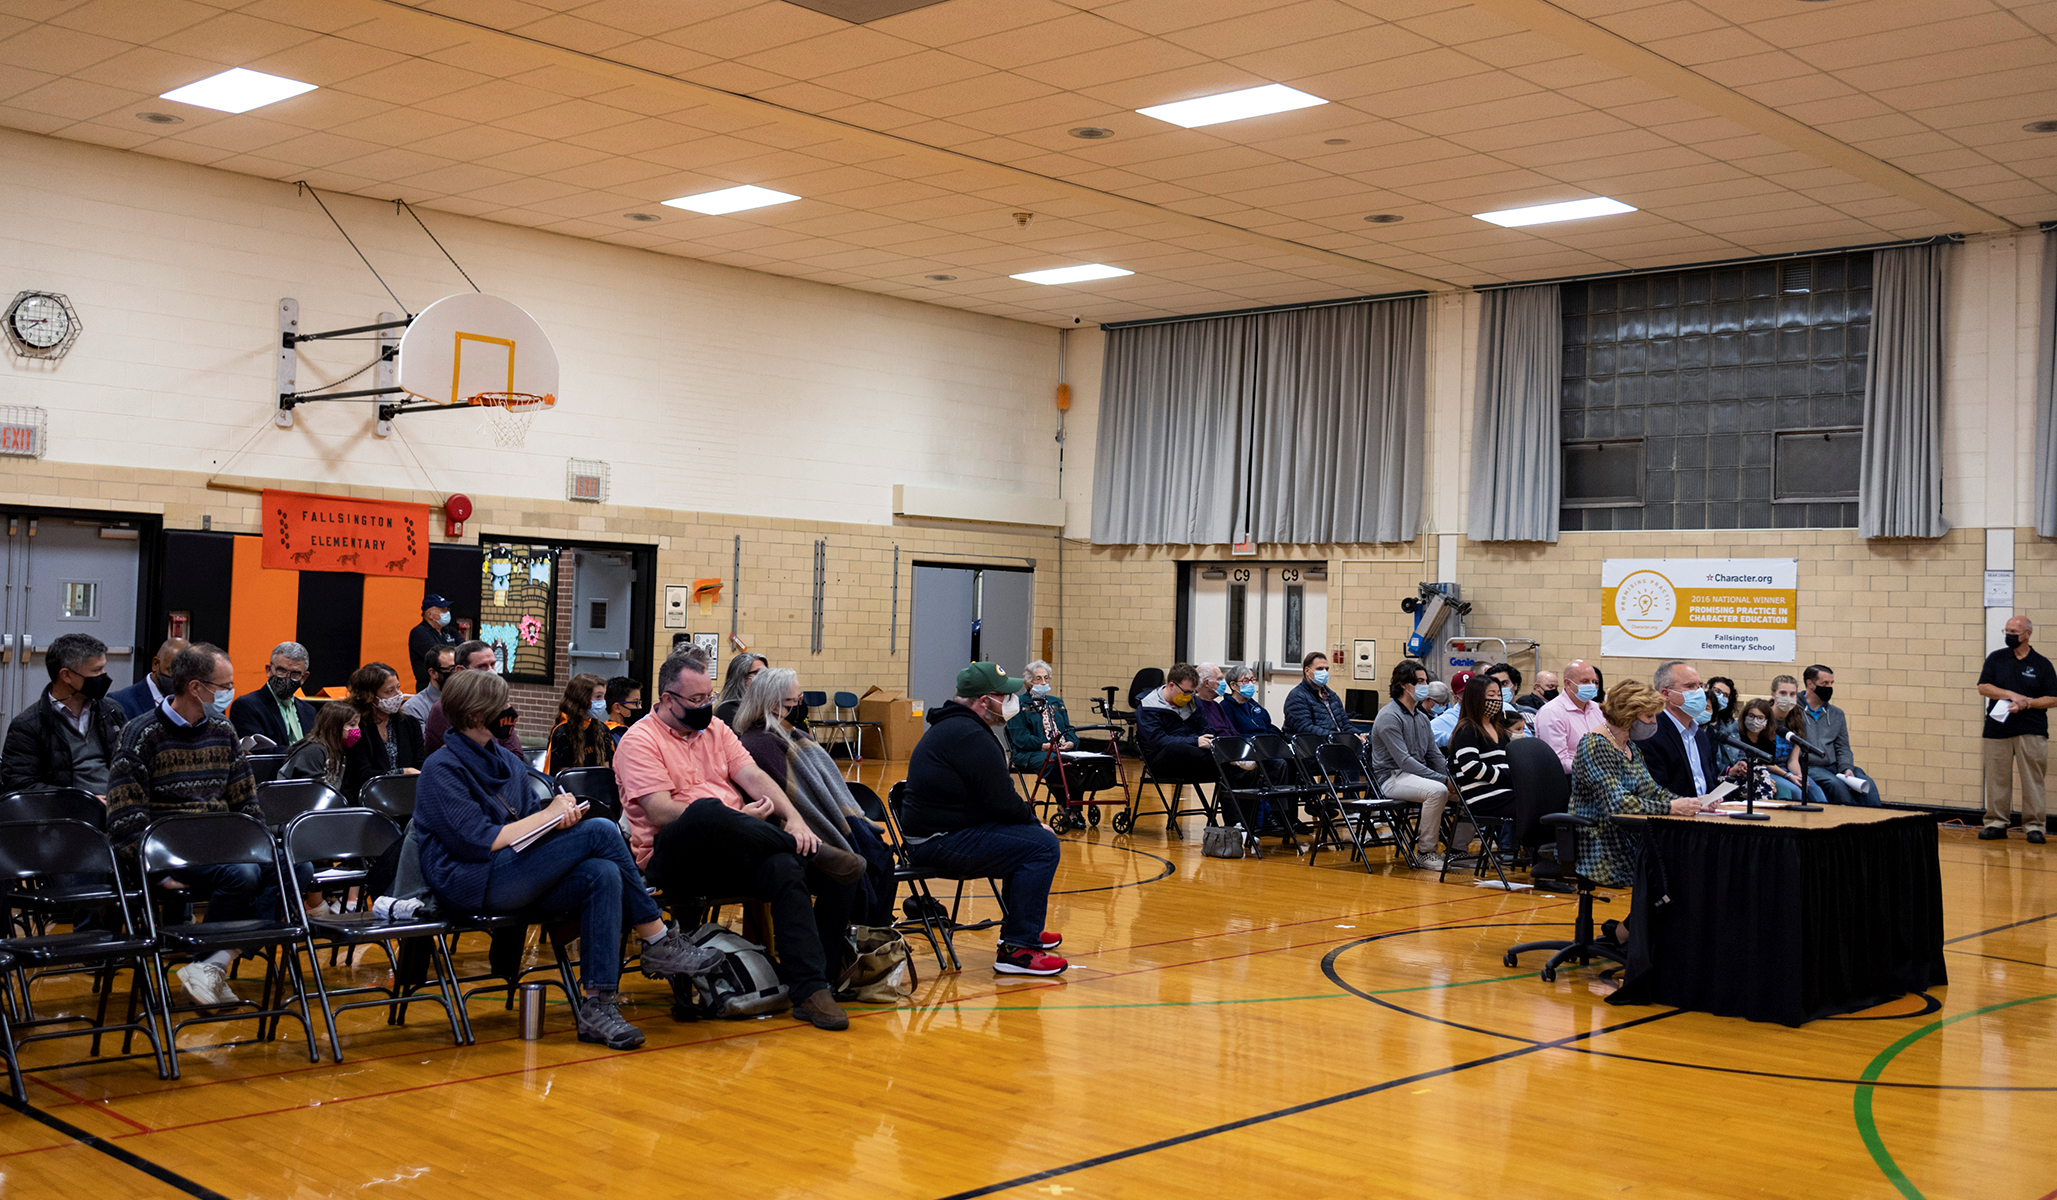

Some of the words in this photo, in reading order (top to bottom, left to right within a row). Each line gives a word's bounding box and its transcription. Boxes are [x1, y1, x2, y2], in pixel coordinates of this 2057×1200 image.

[2, 427, 33, 450] EXIT
[577, 477, 598, 497] EXIT
[302, 510, 392, 528] FALLSINGTON
[311, 535, 386, 551] ELEMENTARY
[1234, 569, 1250, 582] C9
[1282, 569, 1299, 582] C9
[1714, 573, 1773, 584] Character.org
[1621, 579, 1647, 611] PROMISING
[1650, 579, 1671, 611] PRACTICE
[1712, 596, 1751, 604] NATIONAL
[1753, 596, 1786, 604] WINNER
[1689, 606, 1735, 614] PROMISING
[1736, 607, 1777, 615] PRACTICE
[1689, 614, 1738, 623] CHARACTER
[1740, 616, 1788, 624] EDUCATION
[1714, 634, 1759, 642] Fallsington
[1701, 642, 1746, 651] Elementary
[1748, 643, 1775, 651] School
[1449, 657, 1475, 667] Genie
